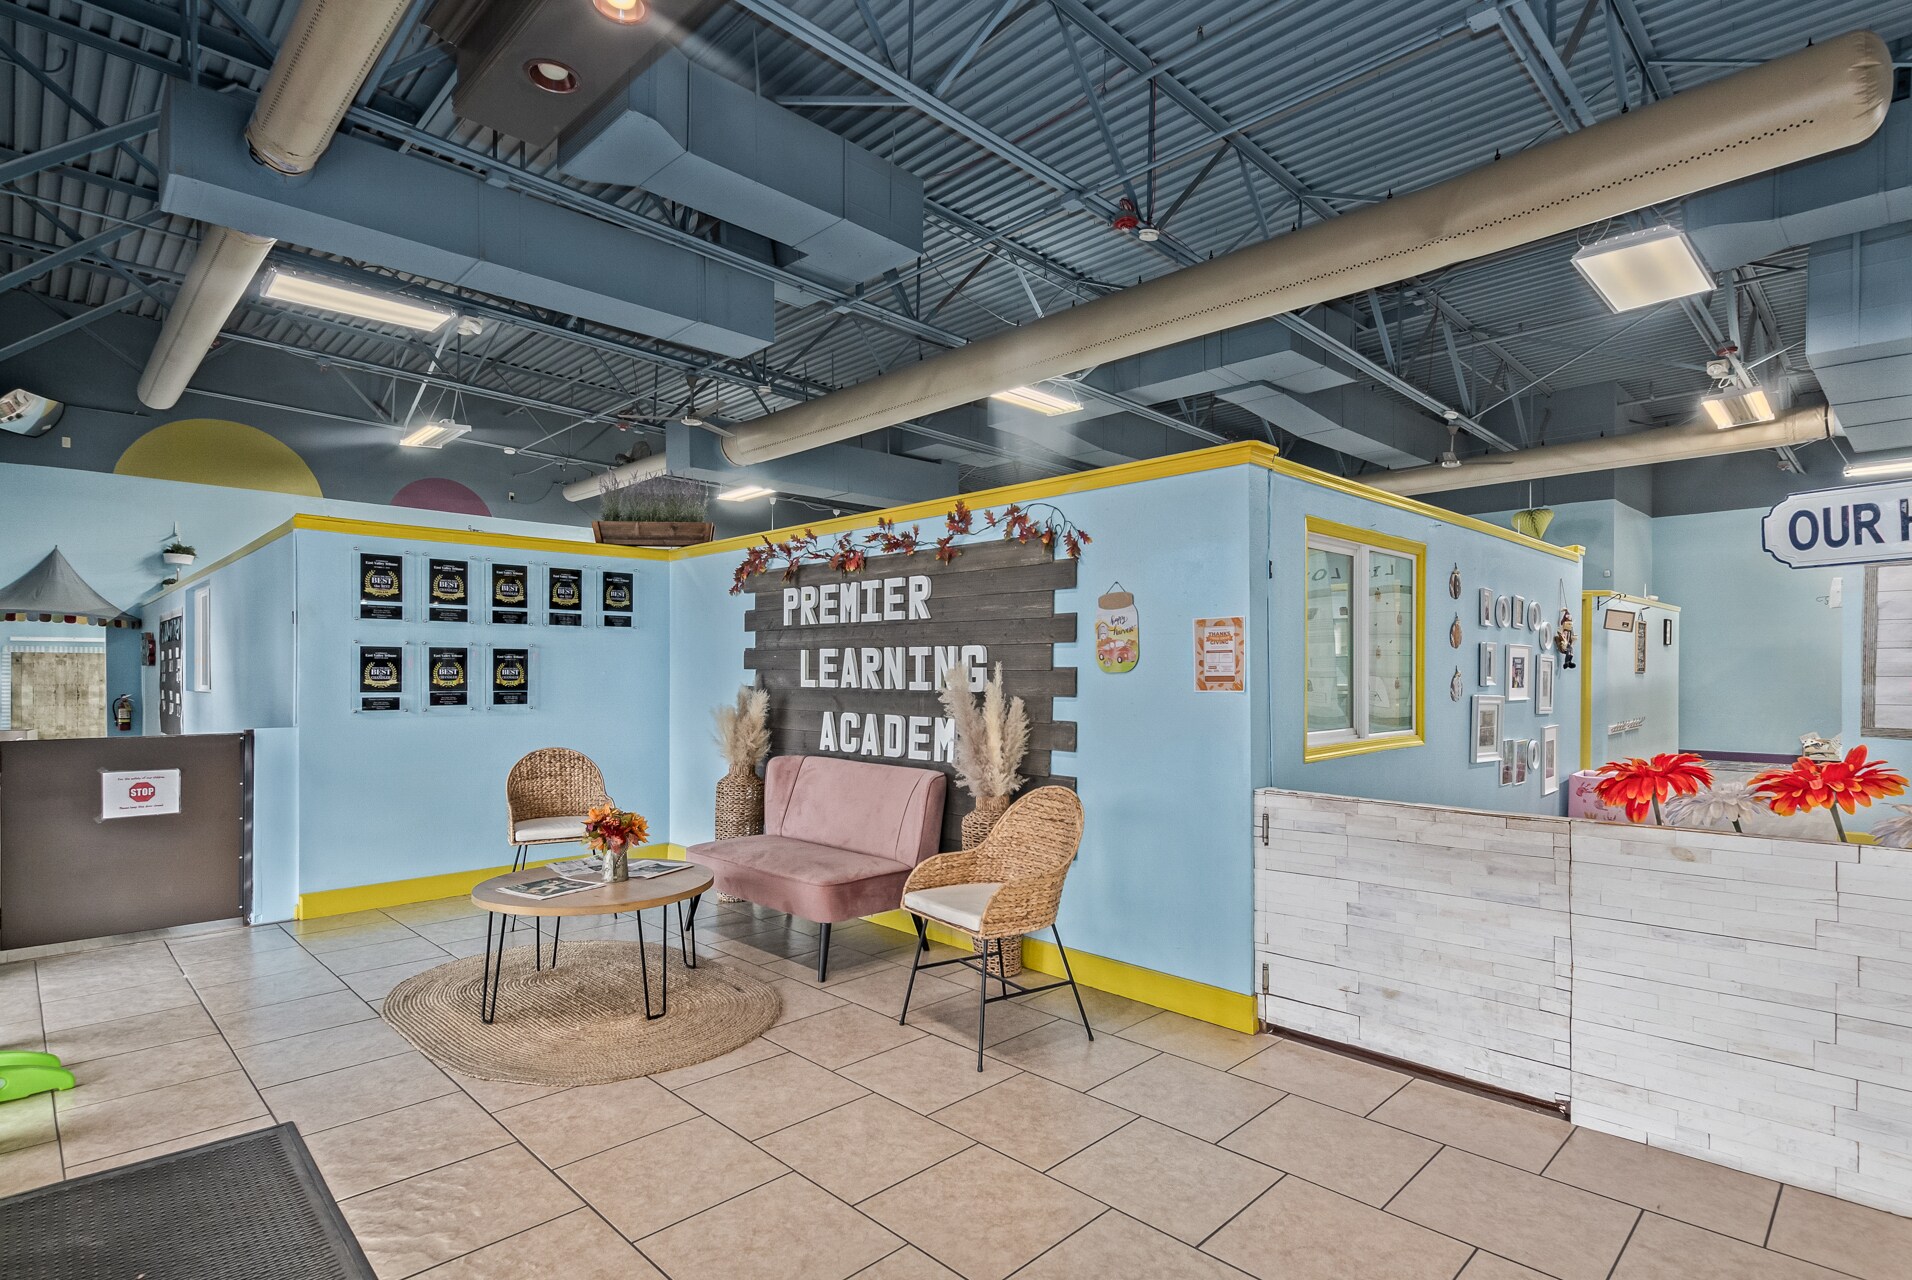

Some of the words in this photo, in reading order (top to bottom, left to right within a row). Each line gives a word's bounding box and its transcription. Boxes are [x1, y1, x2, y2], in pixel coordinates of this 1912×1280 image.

[1788, 502, 1885, 551] OUR
[371, 577, 393, 585] BEST
[783, 575, 933, 626] PREMIER
[800, 644, 988, 693] LEARNING
[819, 711, 957, 763] ACADEM
[130, 787, 154, 797] STOP
